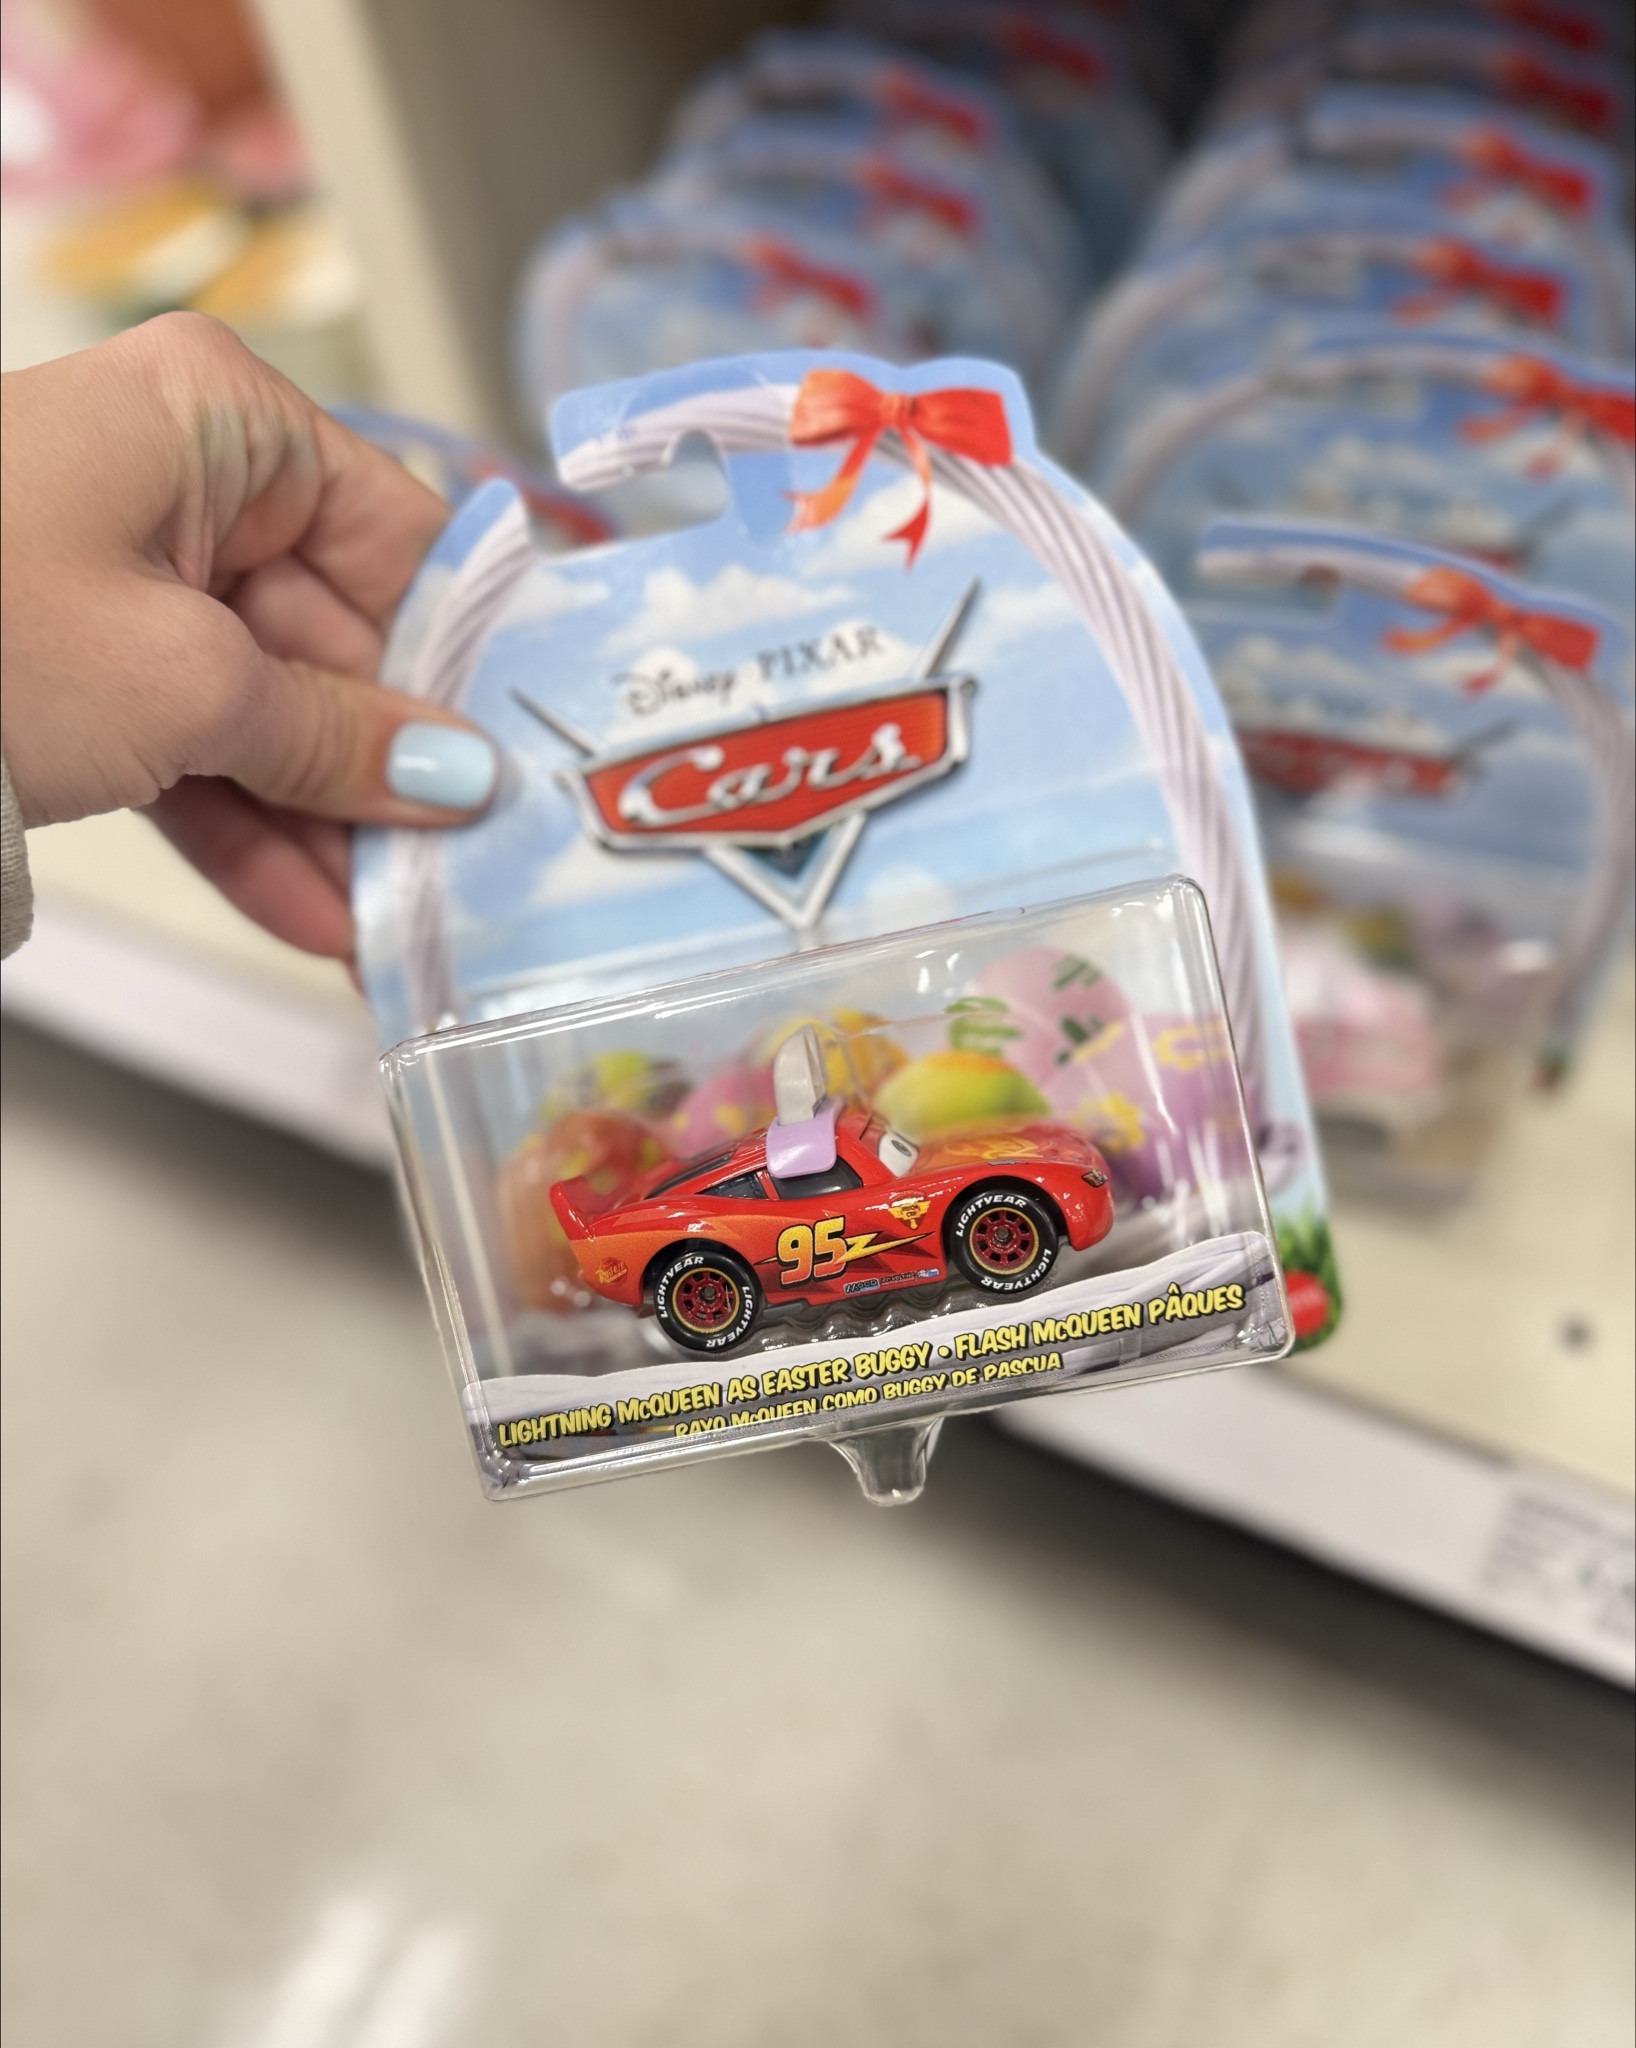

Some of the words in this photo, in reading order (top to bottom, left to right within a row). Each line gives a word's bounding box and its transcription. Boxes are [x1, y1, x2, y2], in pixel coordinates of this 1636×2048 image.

[611, 662, 738, 716] Disney
[756, 626, 882, 681] PIXAR
[619, 723, 920, 828] Cars
[956, 1194, 1028, 1238] LIGHTYEAR
[777, 1215, 847, 1287] 95
[980, 1247, 1053, 1291] LIGHTYEAR
[656, 1256, 705, 1319] LIGHTYEAR
[705, 1285, 754, 1348] LIGHTYEAR
[499, 1403, 614, 1447] LIGHTNING
[616, 1382, 723, 1425] McQUEEN
[727, 1375, 759, 1404] AS
[761, 1357, 851, 1397] EASTER
[853, 1341, 932, 1380] BUGGY
[954, 1323, 1028, 1361] FLASH
[1031, 1302, 1143, 1344] McQUEEN
[1148, 1282, 1246, 1325] PÂQUES
[822, 1387, 879, 1411] COMO
[882, 1373, 948, 1399] BUGGY
[951, 1366, 979, 1389] DE
[983, 1352, 1064, 1381] PASCUA
